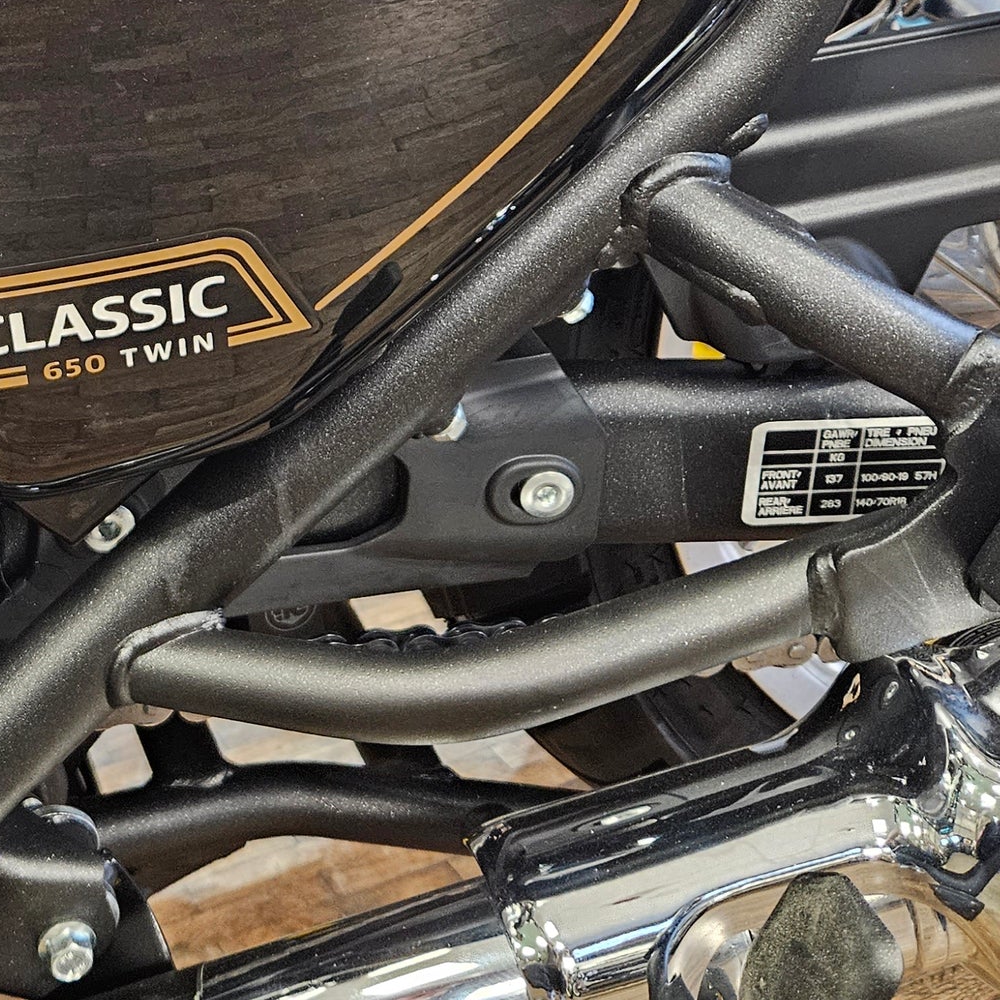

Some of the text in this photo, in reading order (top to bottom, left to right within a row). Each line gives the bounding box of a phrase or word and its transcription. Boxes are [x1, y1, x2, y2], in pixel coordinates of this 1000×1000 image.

[42, 332, 215, 381] 650 TWIN
[865, 427, 891, 437] TIRE
[821, 439, 852, 449] PNBE
[864, 437, 928, 448] DIMENSION
[829, 452, 846, 462] KG
[824, 473, 844, 485] 137
[913, 470, 938, 481] 57H
[760, 479, 798, 491] AVANT
